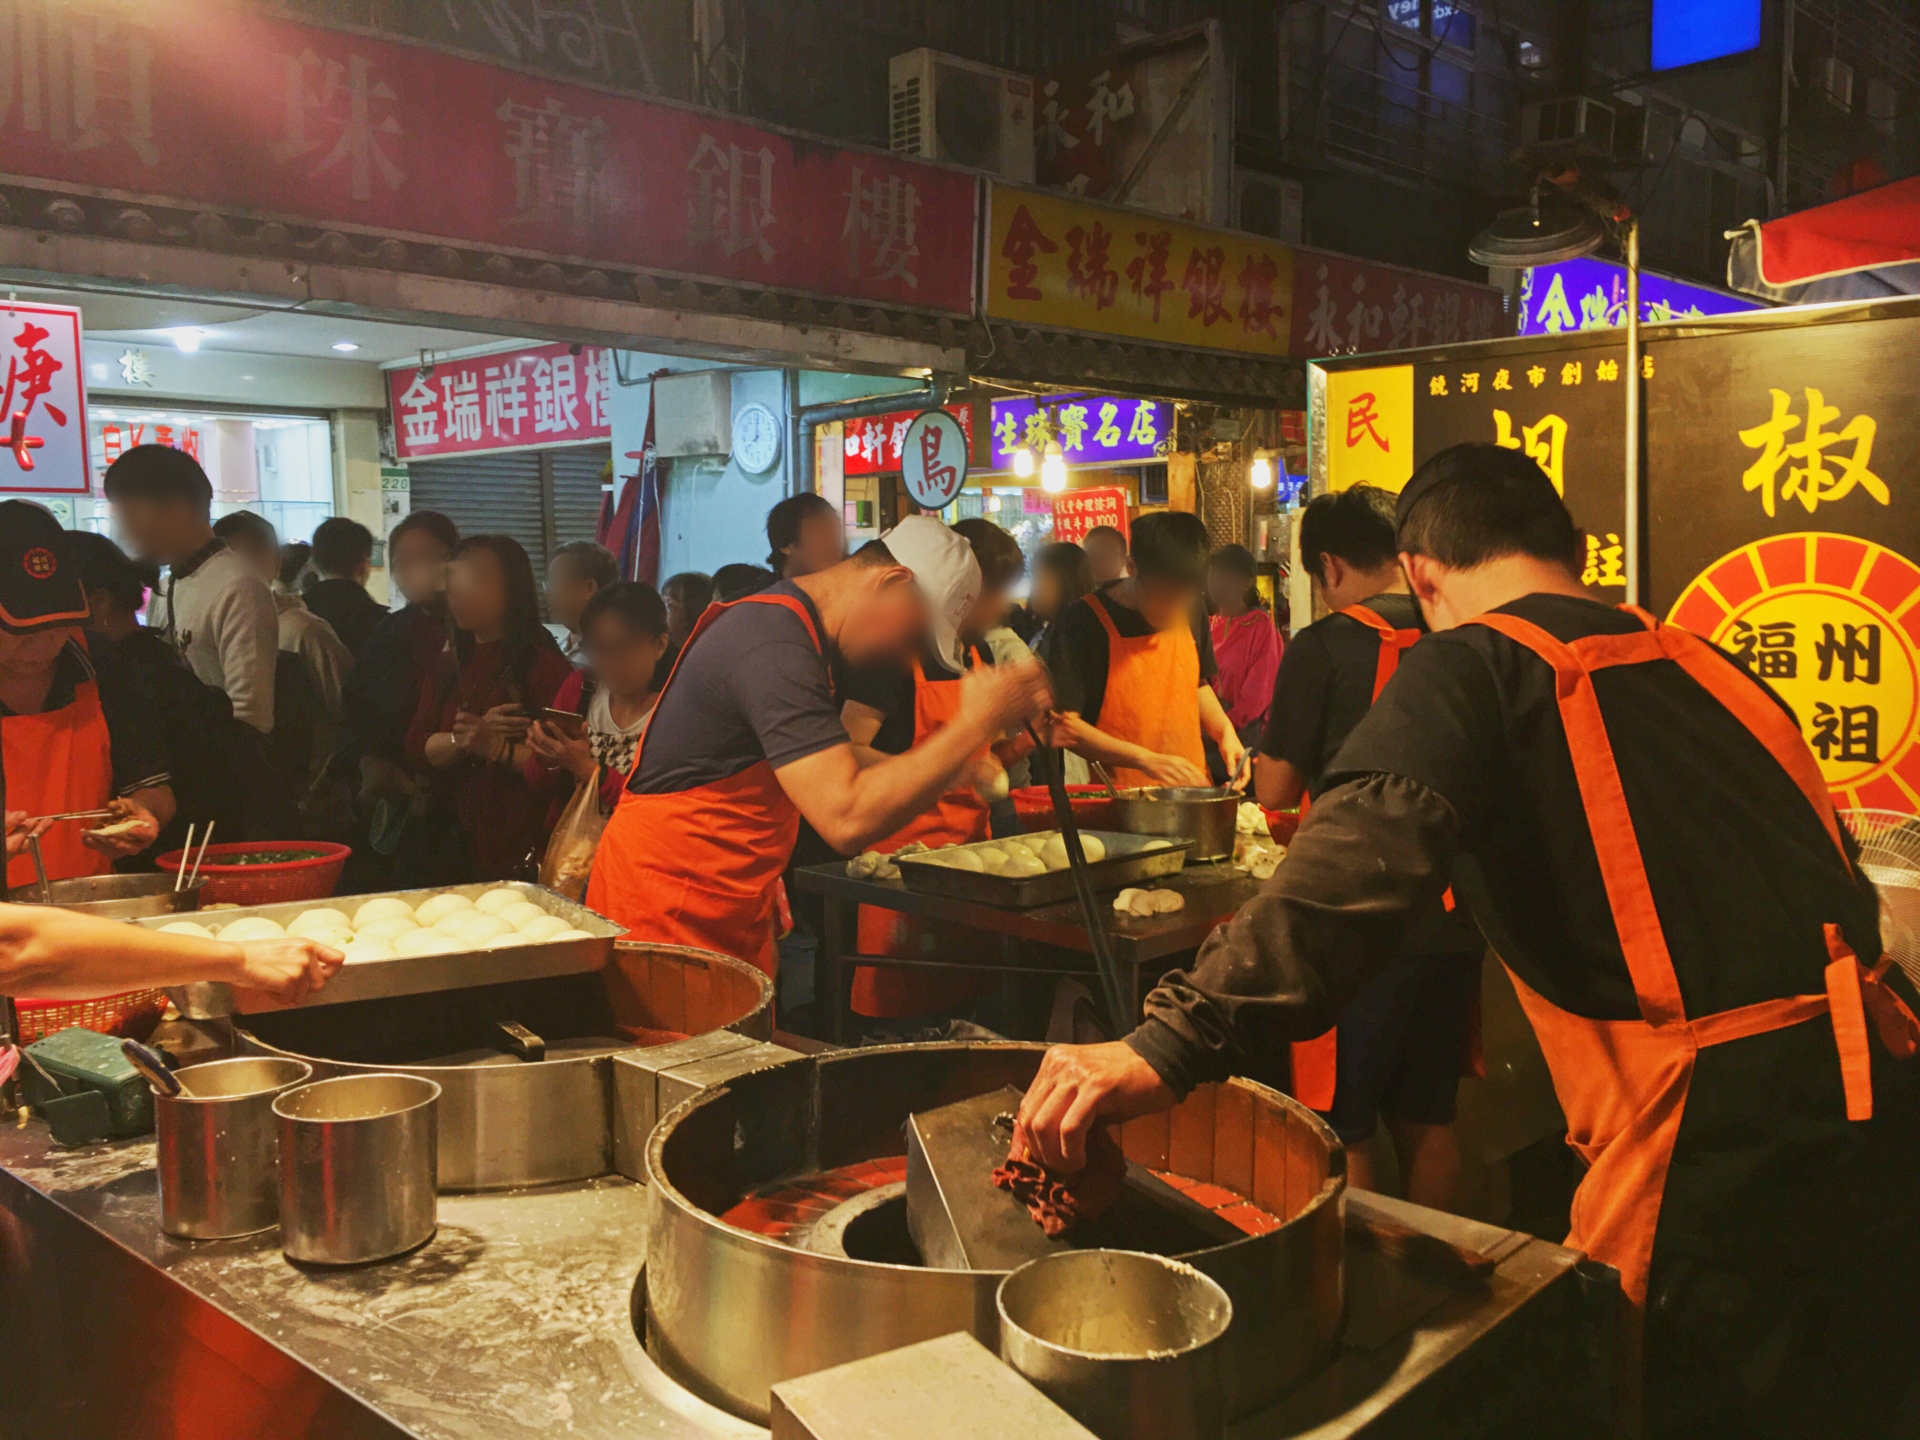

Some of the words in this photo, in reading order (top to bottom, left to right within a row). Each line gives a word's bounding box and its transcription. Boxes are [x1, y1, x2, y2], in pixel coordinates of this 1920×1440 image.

[1002, 204, 1284, 340] 金瑞祥銀樓
[1346, 392, 1390, 453] 民
[381, 478, 409, 490] 220
[917, 424, 957, 496] 鳥
[1733, 620, 1881, 685] 福州
